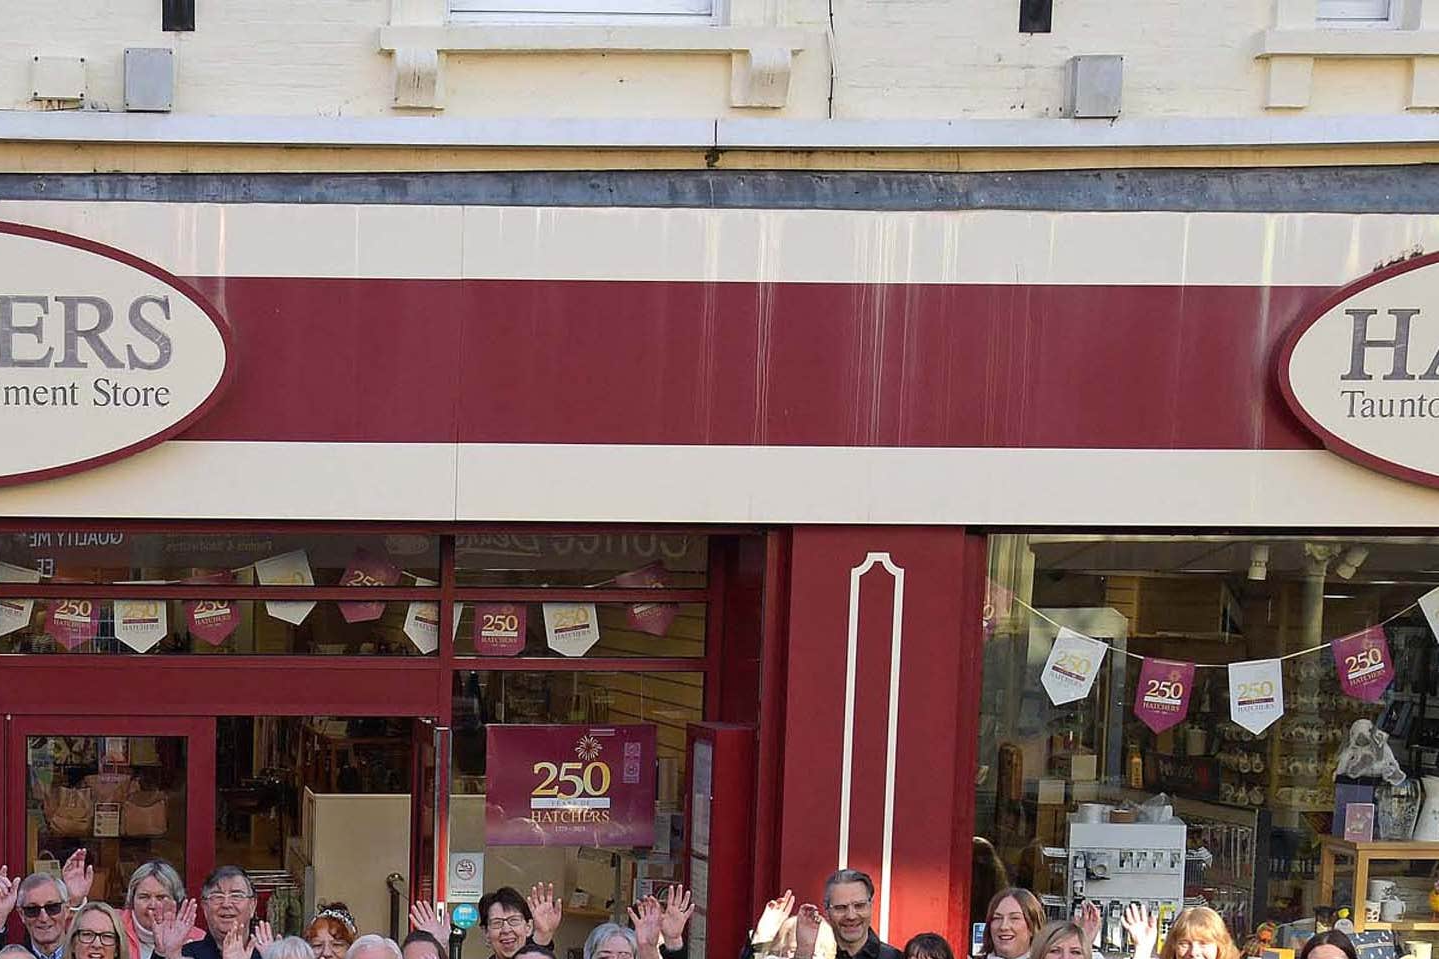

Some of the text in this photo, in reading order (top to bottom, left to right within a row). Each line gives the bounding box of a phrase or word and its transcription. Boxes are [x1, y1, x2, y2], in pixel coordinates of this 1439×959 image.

[92, 377, 170, 407] Store
[56, 600, 92, 617] 250
[482, 614, 519, 632] 250
[1056, 650, 1092, 674] 250
[1345, 648, 1382, 674] 250
[1146, 679, 1184, 699] 250
[1237, 681, 1273, 701] 250
[531, 761, 611, 799] 250
[531, 809, 610, 823] HATCHERS
